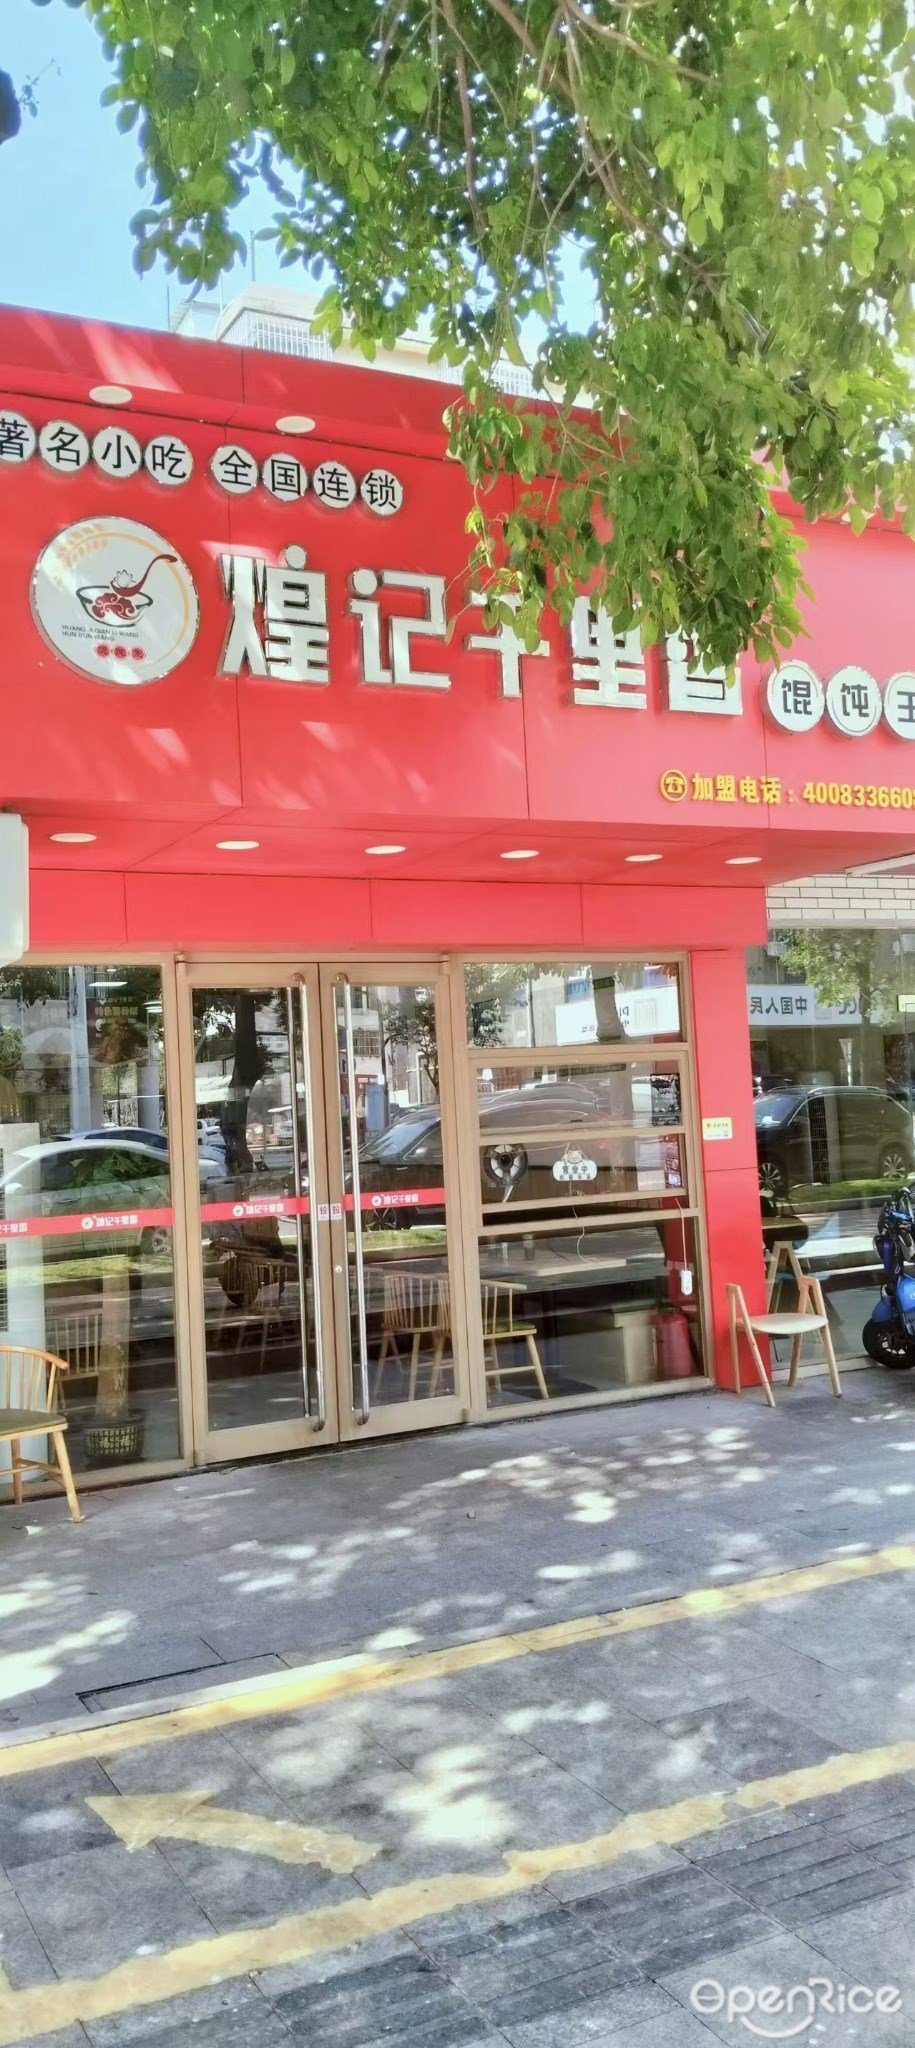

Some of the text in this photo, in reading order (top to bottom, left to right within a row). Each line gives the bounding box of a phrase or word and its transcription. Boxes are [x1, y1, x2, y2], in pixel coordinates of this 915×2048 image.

[0, 418, 397, 509] 著名小吃 全国连锁
[803, 782, 915, 809] 400833660
